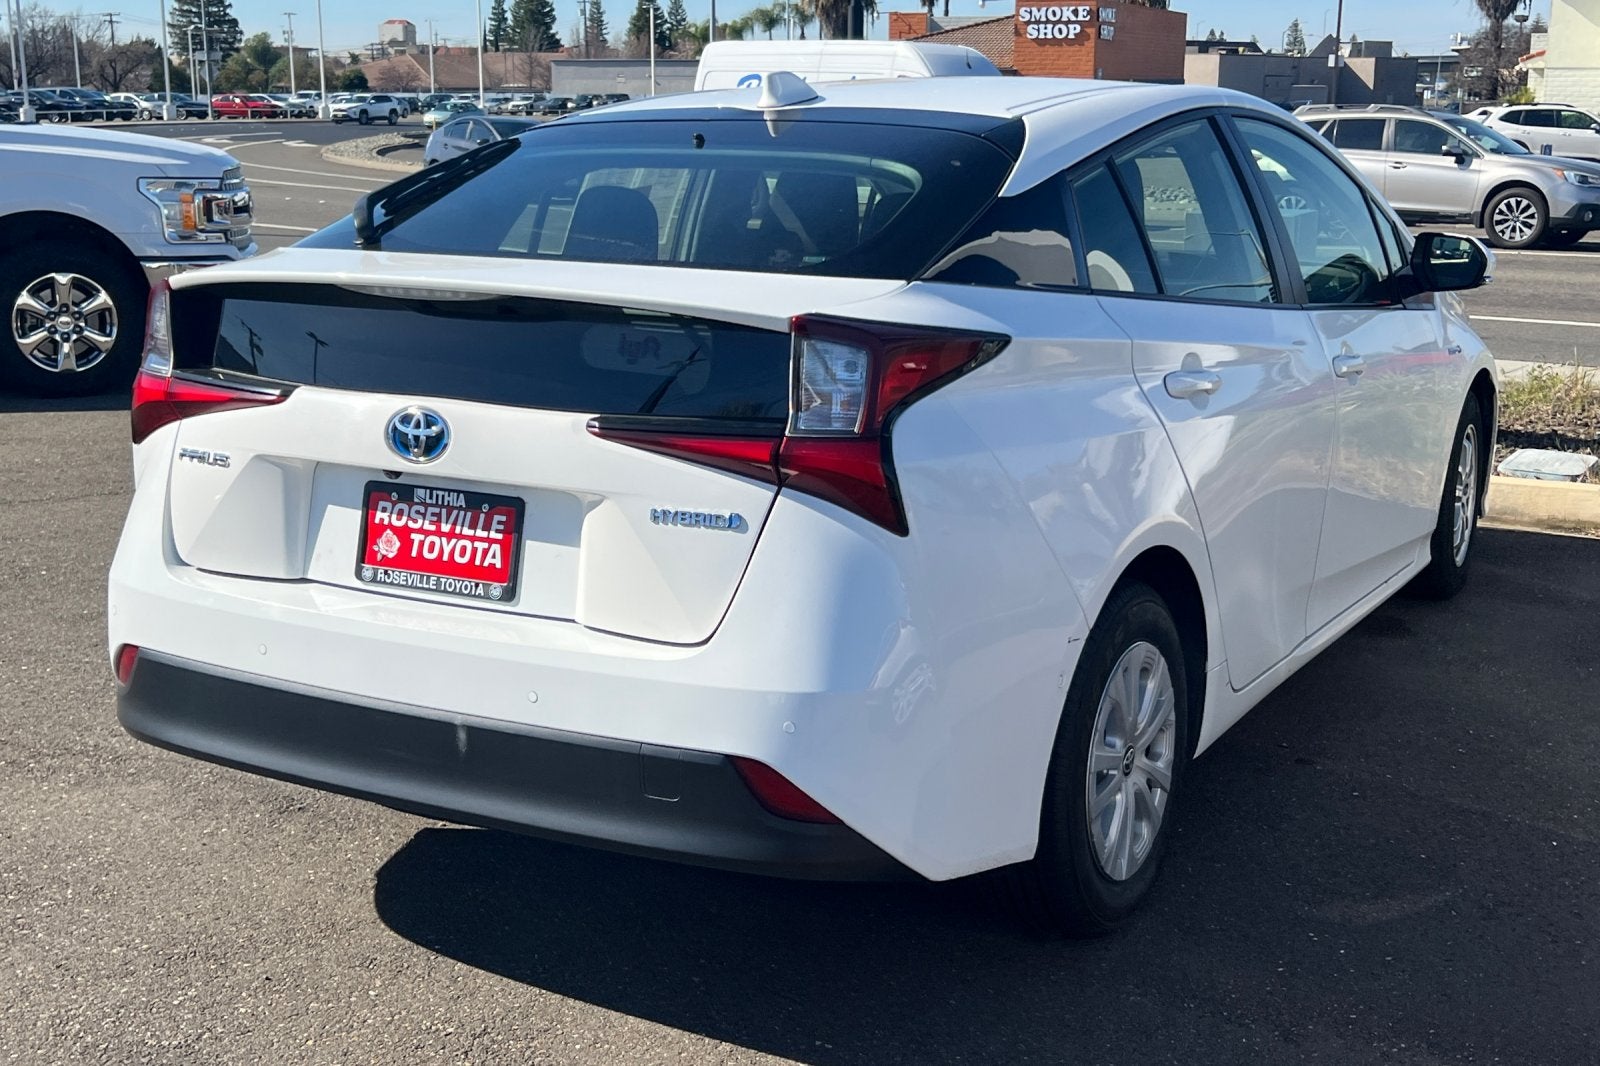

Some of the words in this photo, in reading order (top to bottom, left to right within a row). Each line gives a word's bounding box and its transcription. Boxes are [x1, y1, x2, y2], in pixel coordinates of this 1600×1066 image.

[1018, 6, 1091, 21] SMOKE
[1026, 24, 1081, 39] SHOP
[179, 447, 231, 468] PRIUS
[425, 488, 466, 508] LITHIA
[374, 500, 507, 540] ROSEVILLE
[649, 508, 729, 530] HYBRID
[410, 532, 503, 569] TOYOTA
[377, 569, 437, 589] ROSEVILLE
[440, 577, 485, 597] TOYOTA
